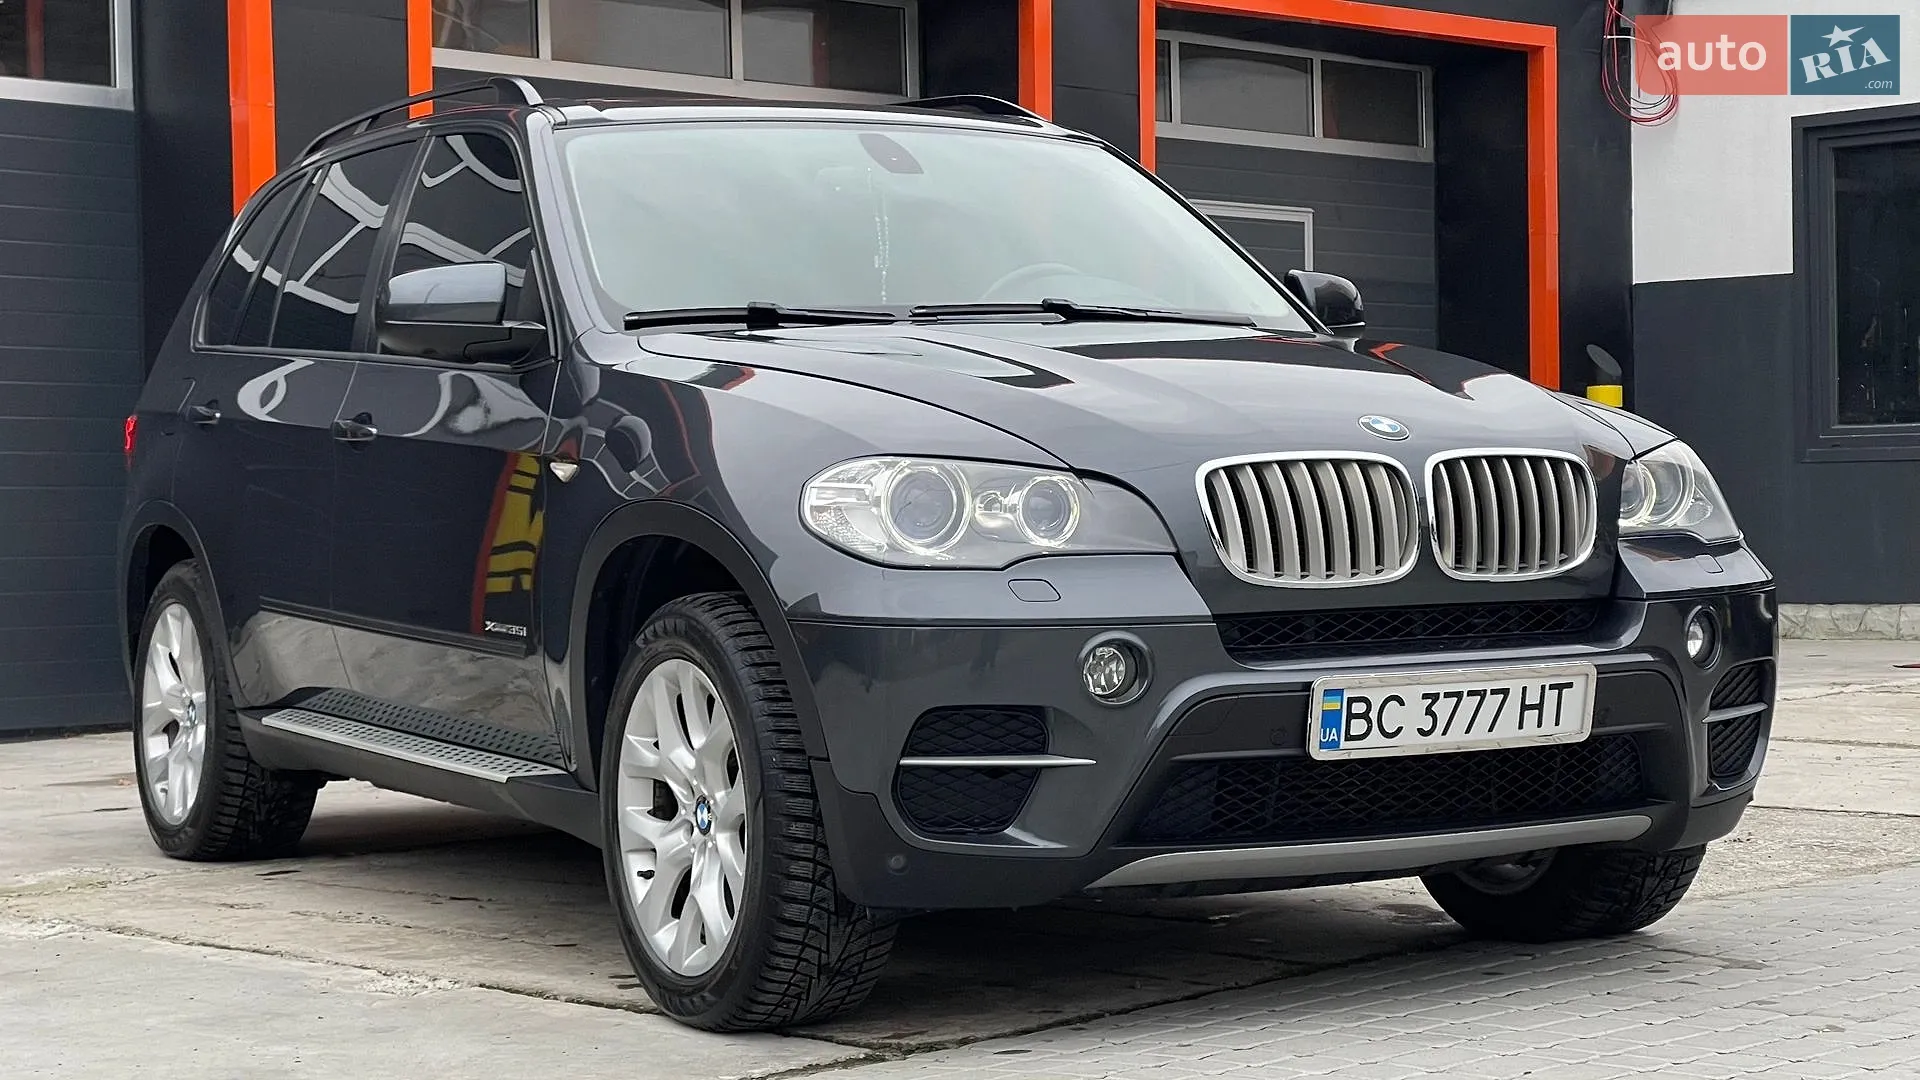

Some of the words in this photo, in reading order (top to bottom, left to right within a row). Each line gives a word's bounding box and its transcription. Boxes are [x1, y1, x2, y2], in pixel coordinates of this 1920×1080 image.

[1344, 695, 1406, 742] BC
[1416, 687, 1511, 738] 3777
[1518, 681, 1574, 730] HT
[1320, 727, 1338, 742] UA
